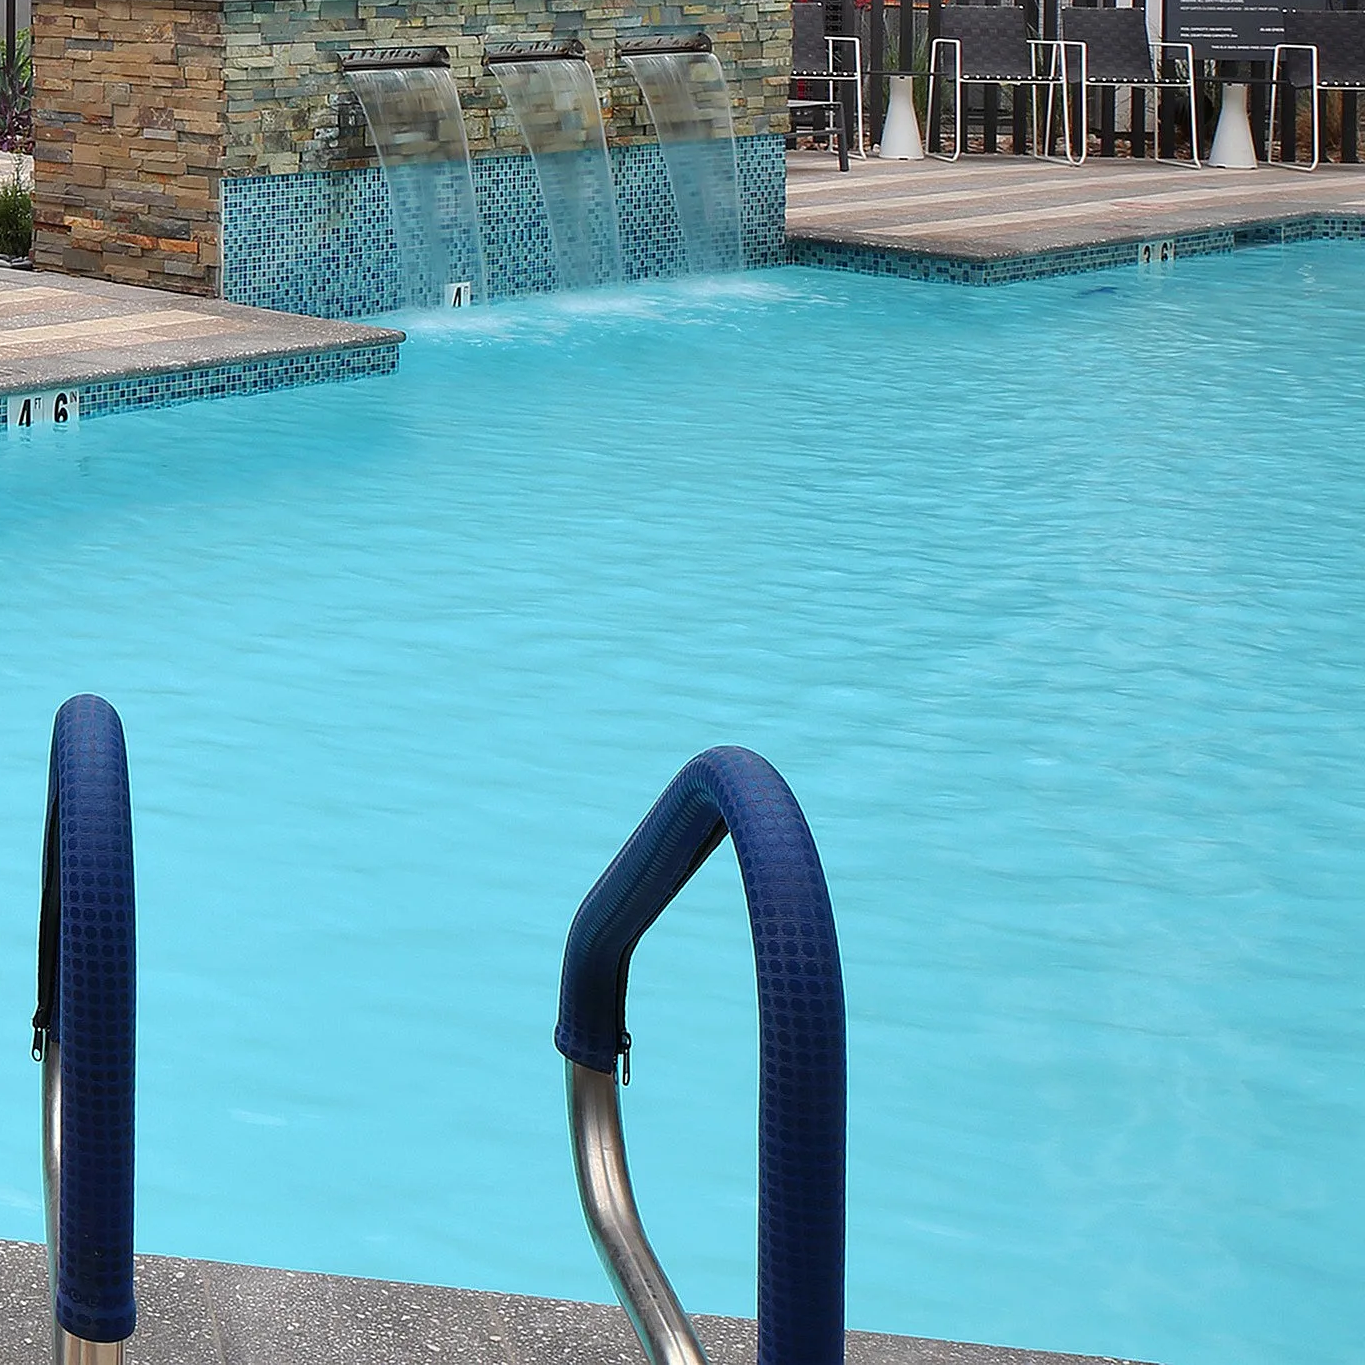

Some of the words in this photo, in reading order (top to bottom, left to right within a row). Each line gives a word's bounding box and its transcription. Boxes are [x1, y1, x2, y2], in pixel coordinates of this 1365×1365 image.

[1160, 242, 1169, 262] 6
[18, 398, 32, 427] 4
[54, 392, 69, 423] 6
